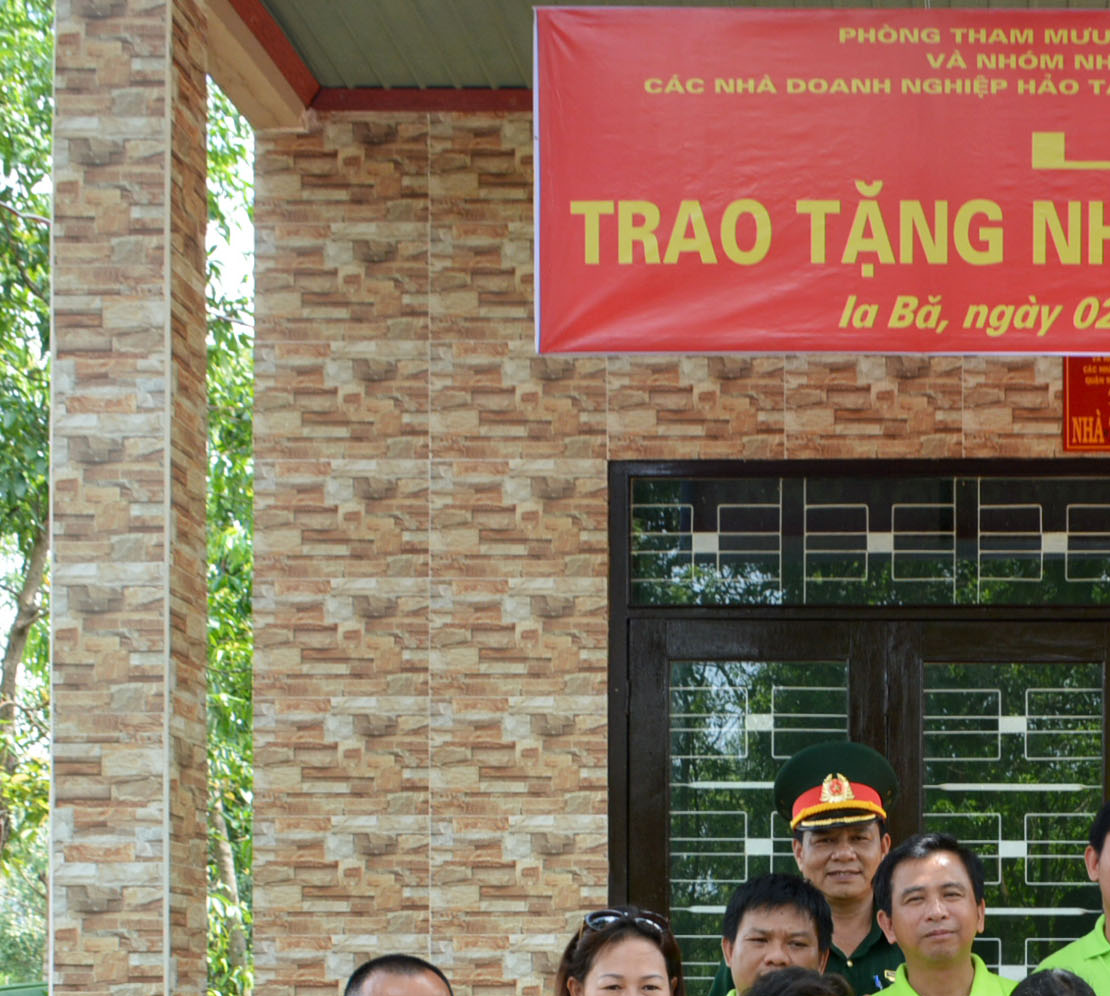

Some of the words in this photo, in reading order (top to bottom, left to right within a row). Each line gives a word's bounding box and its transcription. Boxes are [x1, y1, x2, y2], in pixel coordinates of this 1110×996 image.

[840, 25, 941, 43] PHÒNG
[952, 28, 1034, 44] THAM
[927, 50, 967, 69] VÀ
[977, 50, 1064, 69] NHÓM
[645, 75, 705, 93] CÁC
[715, 75, 777, 93] NHÀ
[787, 79, 892, 94] DOANH
[901, 75, 1008, 98] NGHIỆP
[1017, 74, 1080, 95] HẢO
[570, 198, 773, 265] TRAO
[796, 180, 1004, 277] TẶNG
[889, 295, 949, 334] Bă,
[963, 296, 1063, 337] ngày
[1072, 408, 1105, 444] NHÀ
